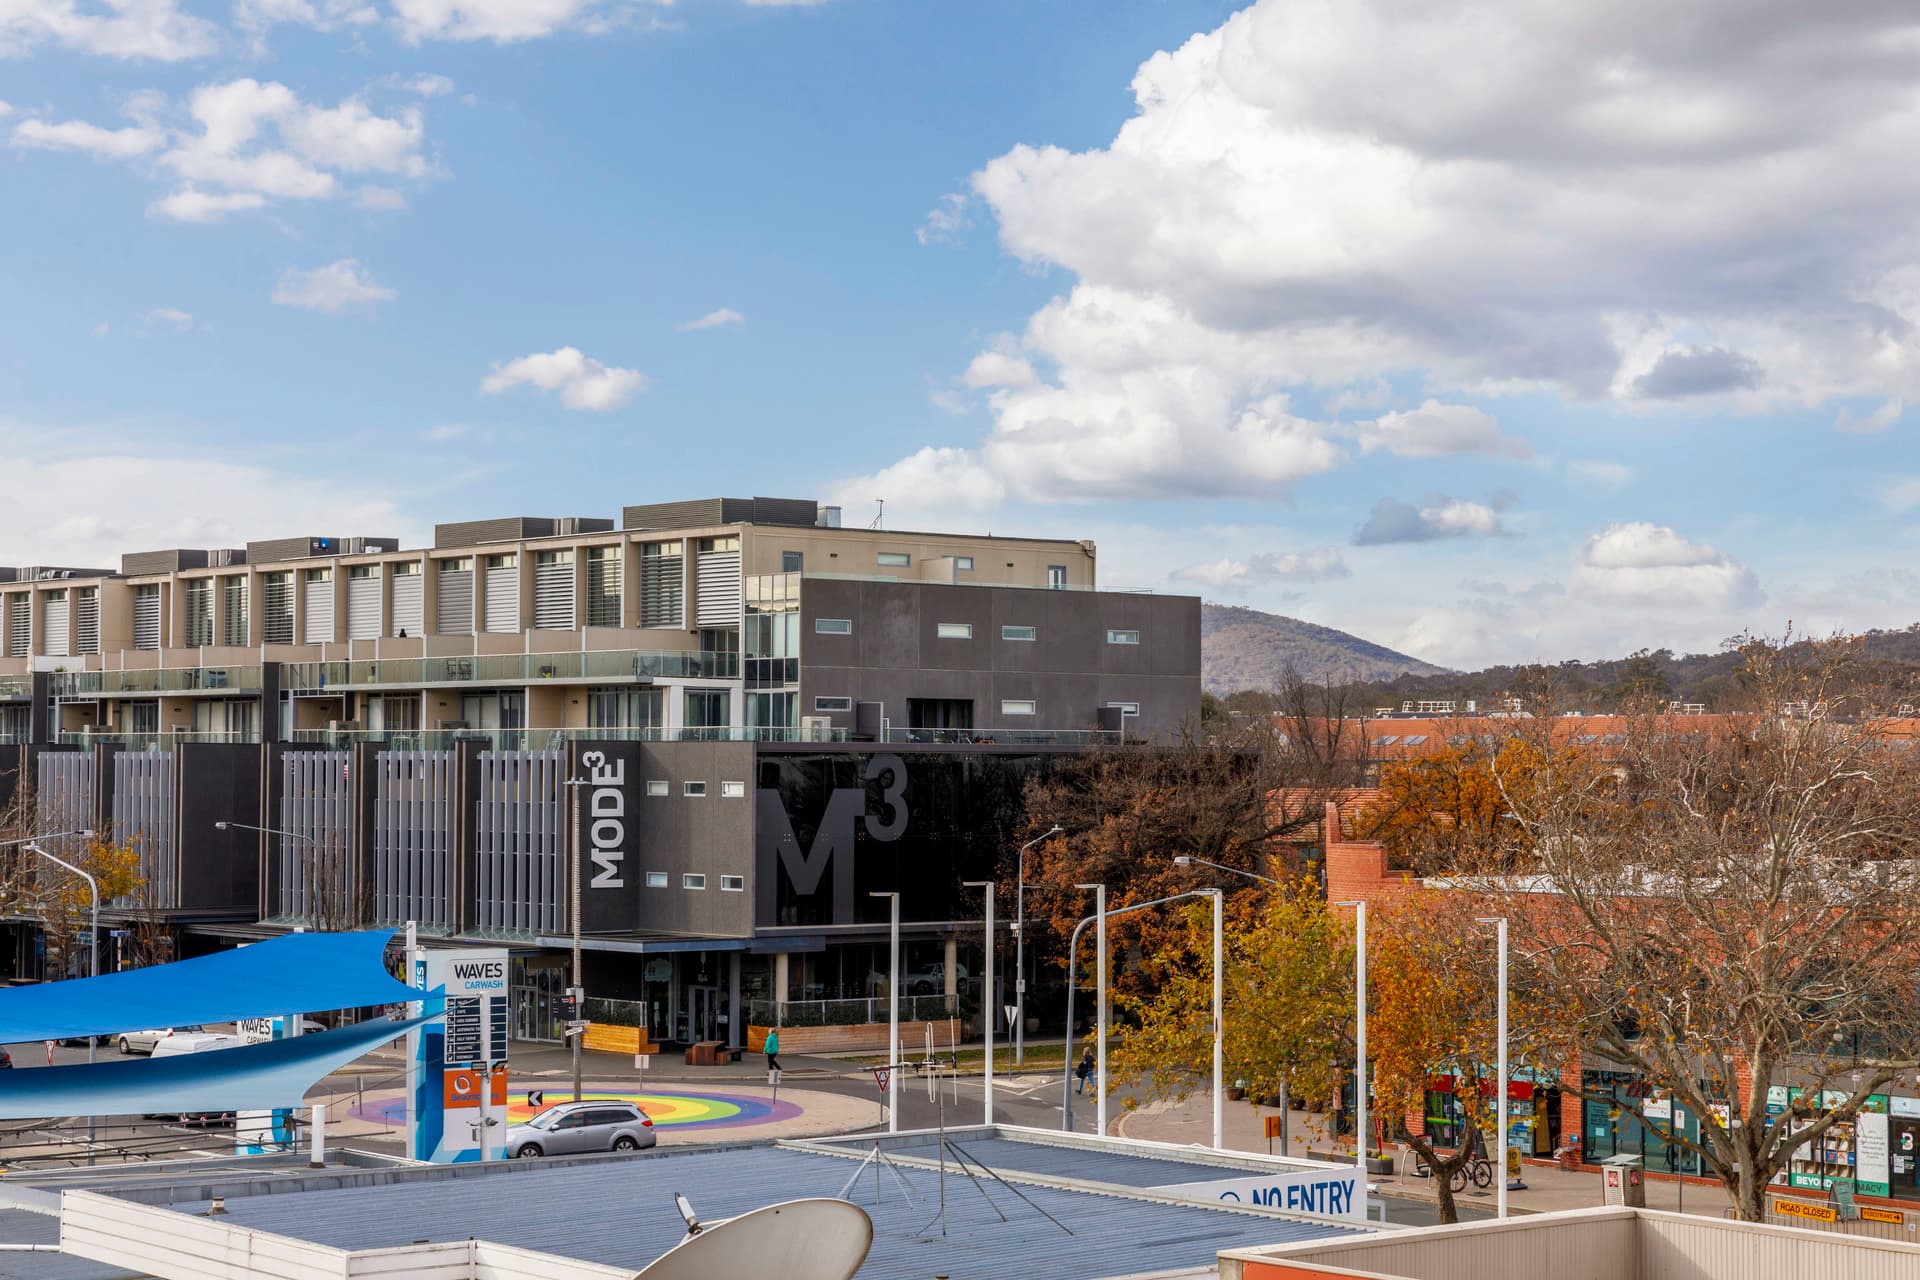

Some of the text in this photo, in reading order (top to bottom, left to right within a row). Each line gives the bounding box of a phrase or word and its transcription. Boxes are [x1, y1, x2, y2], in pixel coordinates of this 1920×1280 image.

[454, 963, 503, 979] WAVES
[464, 980, 503, 989] CARWASH
[240, 1018, 270, 1035] WAVES
[1253, 1179, 1355, 1215] NO ENTRY
[1779, 1203, 1831, 1219] ROAD CLOSED
